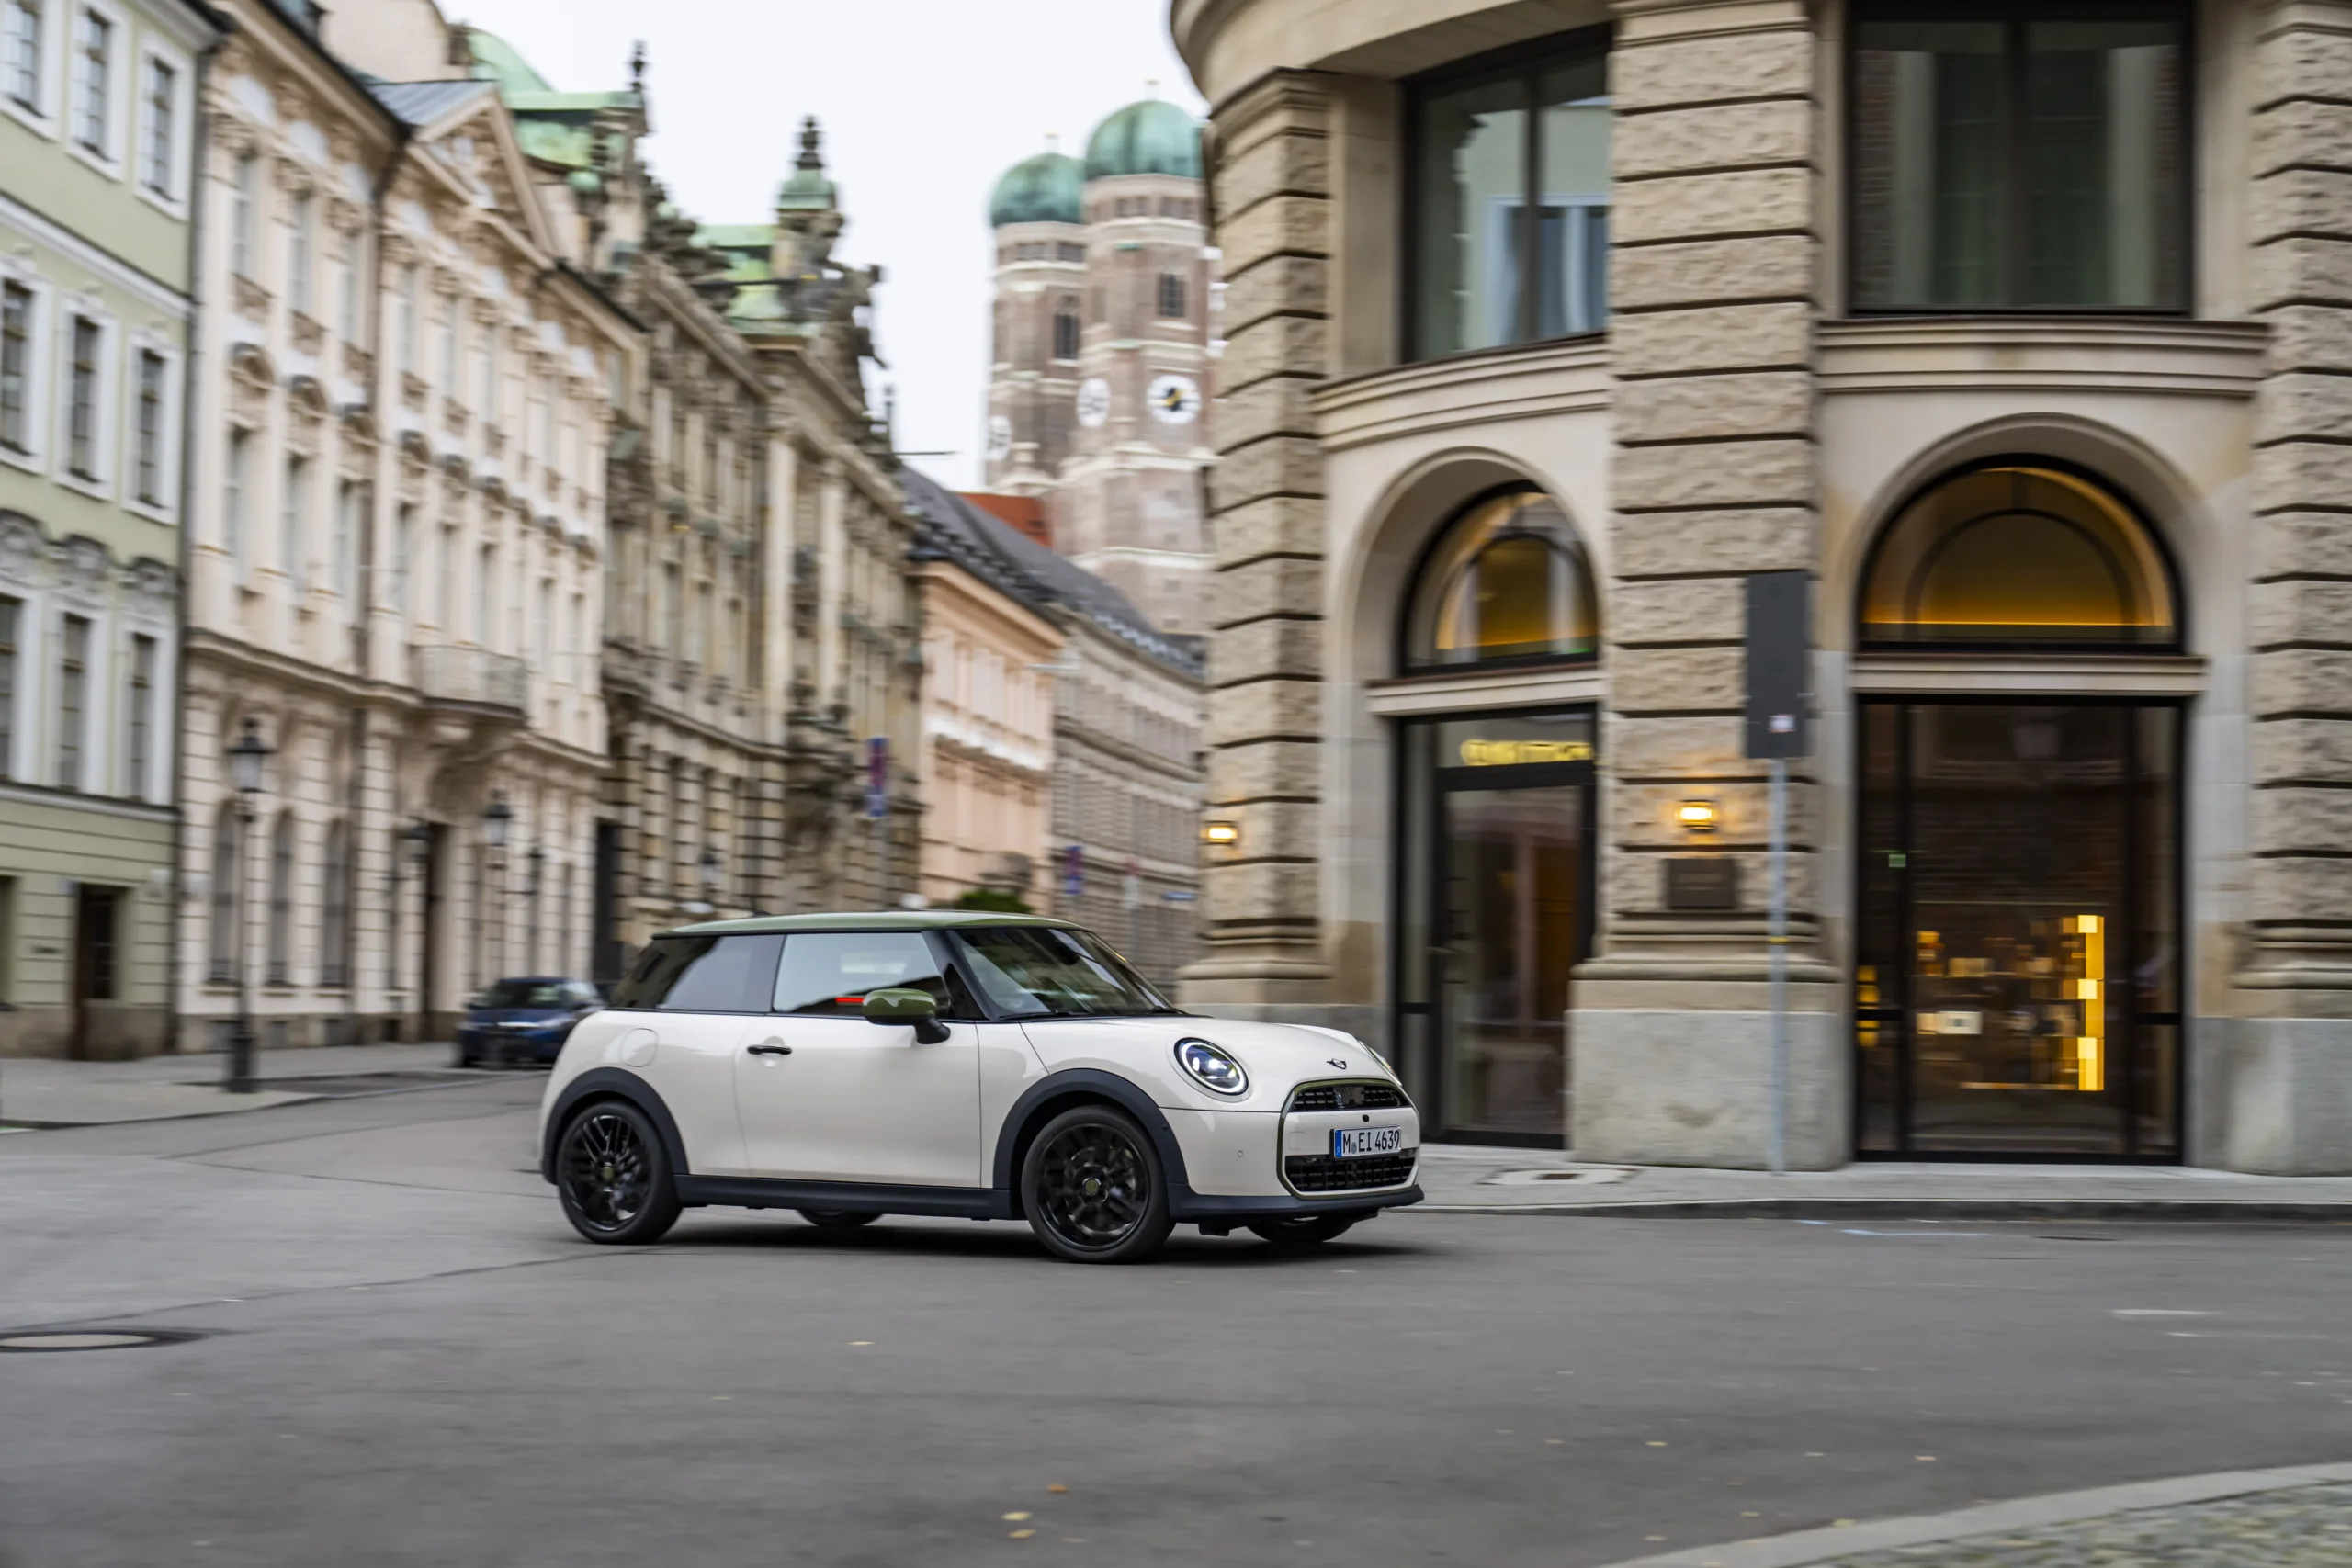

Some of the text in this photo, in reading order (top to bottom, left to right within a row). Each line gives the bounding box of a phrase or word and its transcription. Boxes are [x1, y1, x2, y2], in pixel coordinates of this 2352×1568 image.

[1343, 1130, 1400, 1154] M EI 4639
